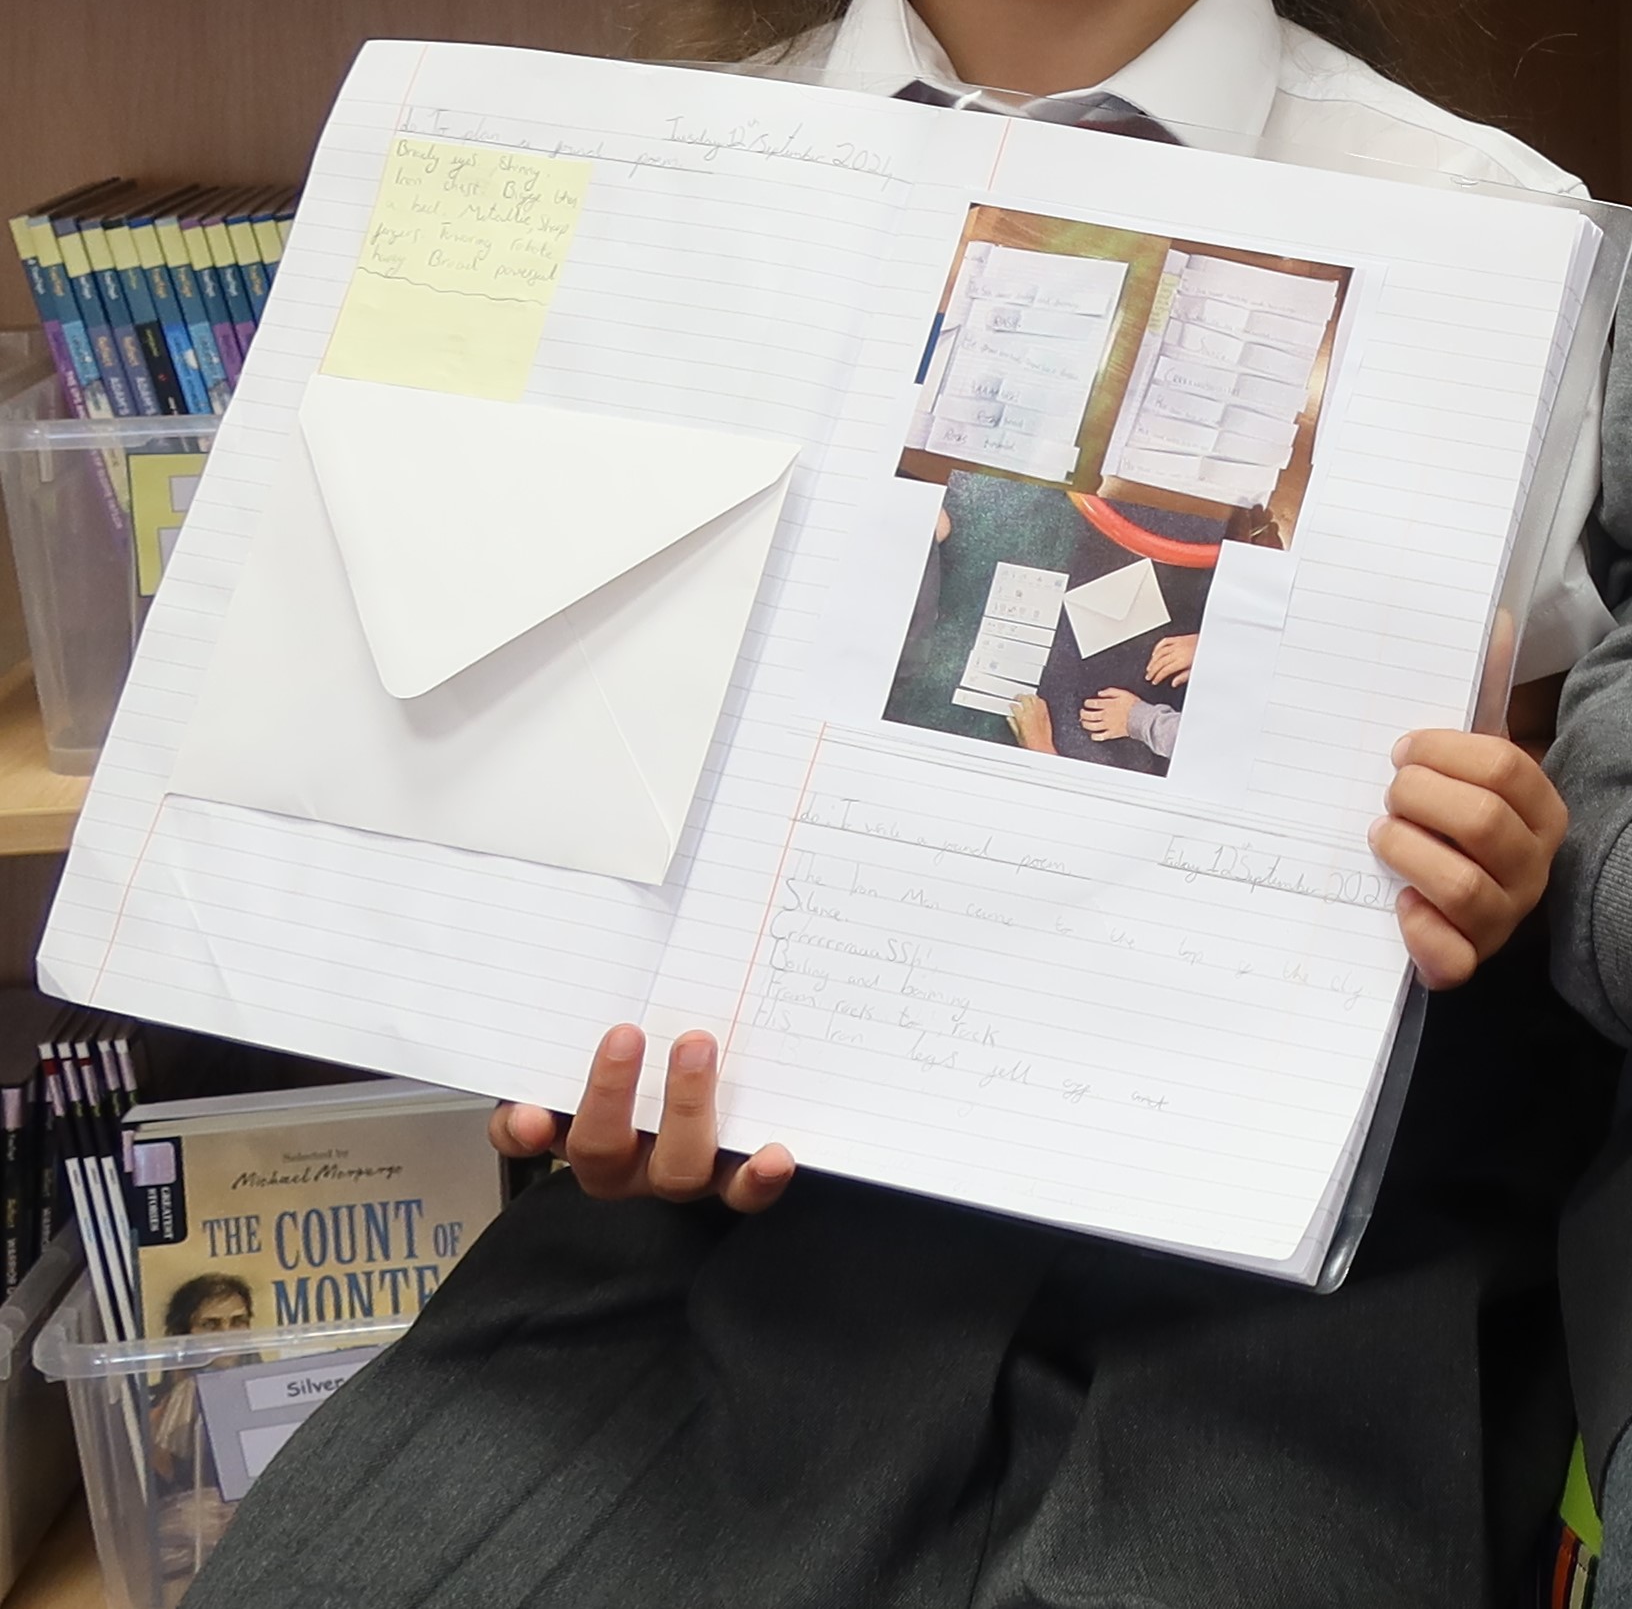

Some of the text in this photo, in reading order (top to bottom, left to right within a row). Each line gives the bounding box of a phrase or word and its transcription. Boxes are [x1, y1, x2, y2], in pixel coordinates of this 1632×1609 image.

[202, 1198, 464, 1271] THE COUNT OF
[271, 1264, 442, 1327] MONTE
